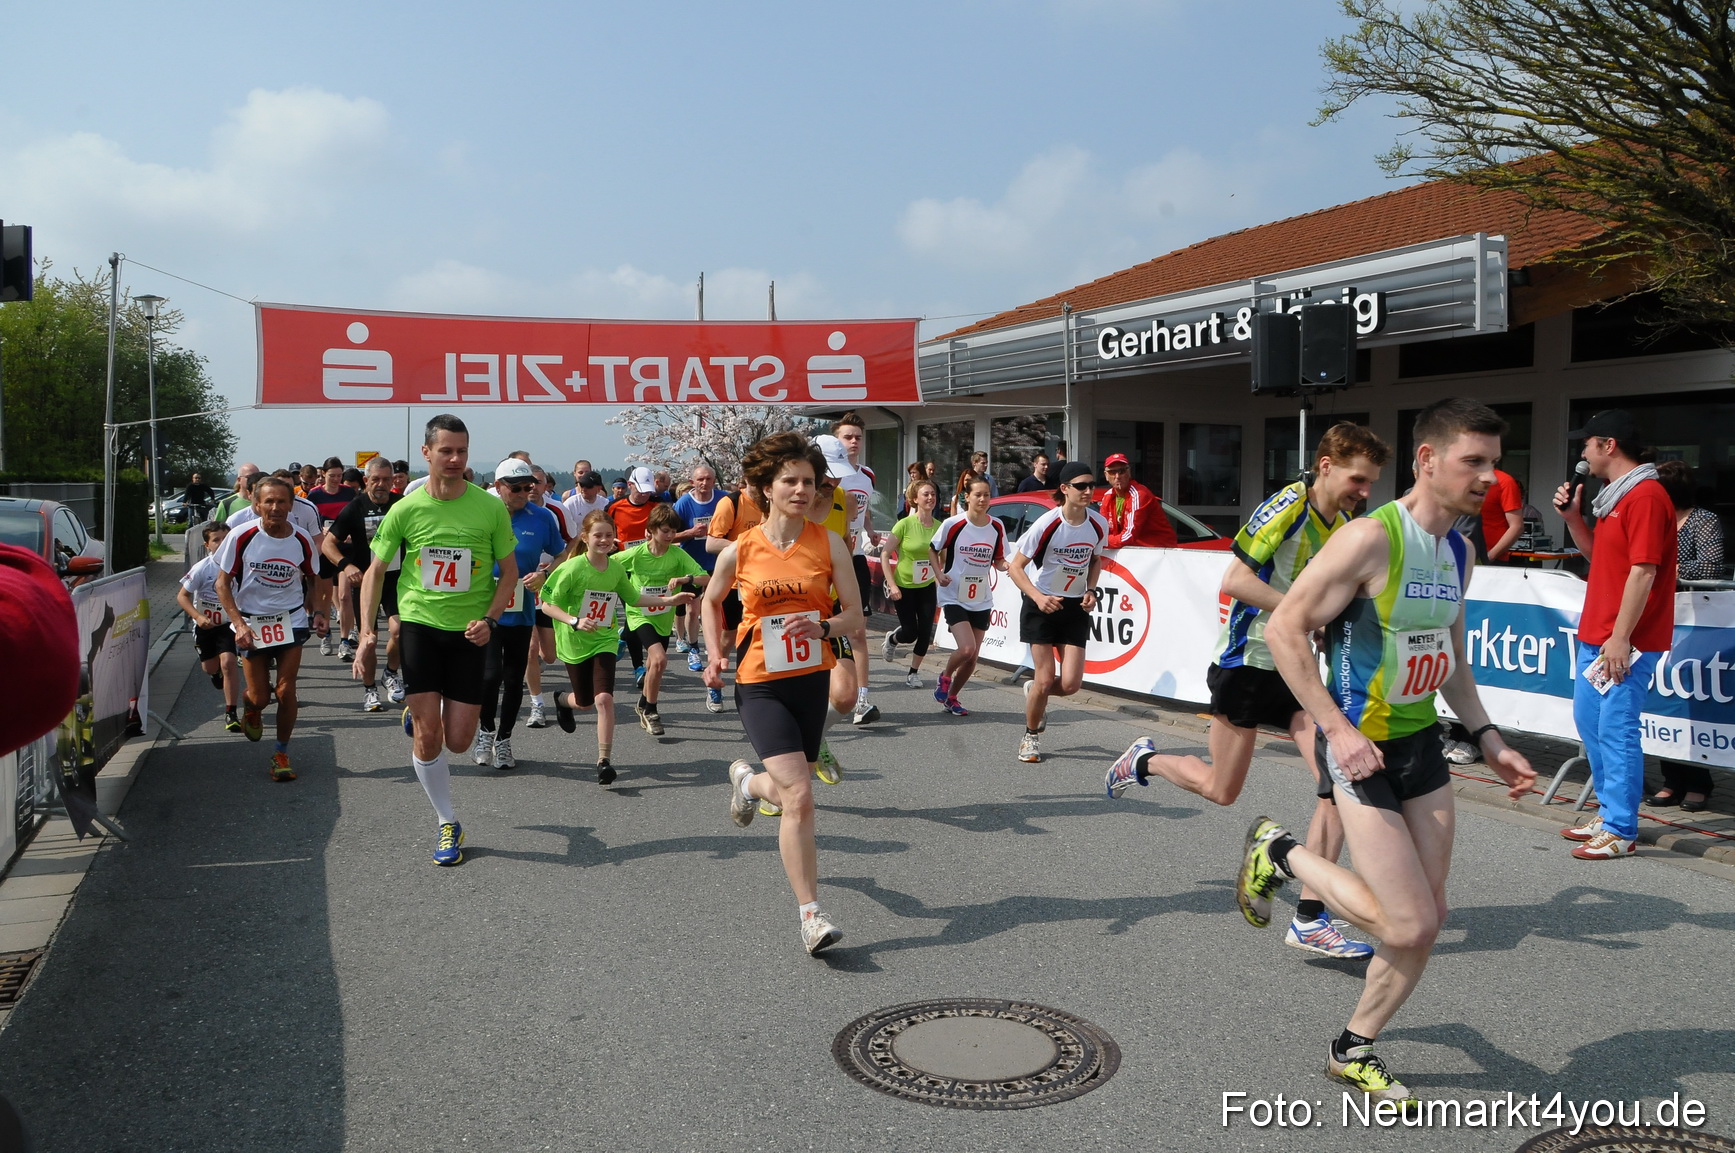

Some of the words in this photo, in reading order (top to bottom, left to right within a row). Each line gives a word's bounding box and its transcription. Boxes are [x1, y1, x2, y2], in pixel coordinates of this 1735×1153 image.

[1098, 312, 1222, 360] Gerhart
[1233, 307, 1251, 340] &
[1245, 487, 1299, 538] BOCK
[429, 548, 452, 556] MEYER
[959, 545, 990, 554] GERHART
[249, 561, 292, 572] GERHART
[432, 560, 458, 588] 74
[921, 566, 929, 581] 2
[1410, 567, 1444, 581] TEAM
[762, 582, 808, 598] OEXL
[967, 583, 977, 599] 8
[1063, 575, 1076, 592] 7
[1405, 581, 1459, 602] BOCK
[586, 600, 608, 622] 34
[1120, 594, 1134, 611] &
[990, 609, 1008, 629] ORS
[261, 623, 285, 644] 66
[1090, 614, 1134, 646] NIG
[1407, 633, 1436, 645] MEYER
[781, 631, 810, 663] 15
[1466, 617, 1556, 675] rkter
[1401, 651, 1450, 697] 100
